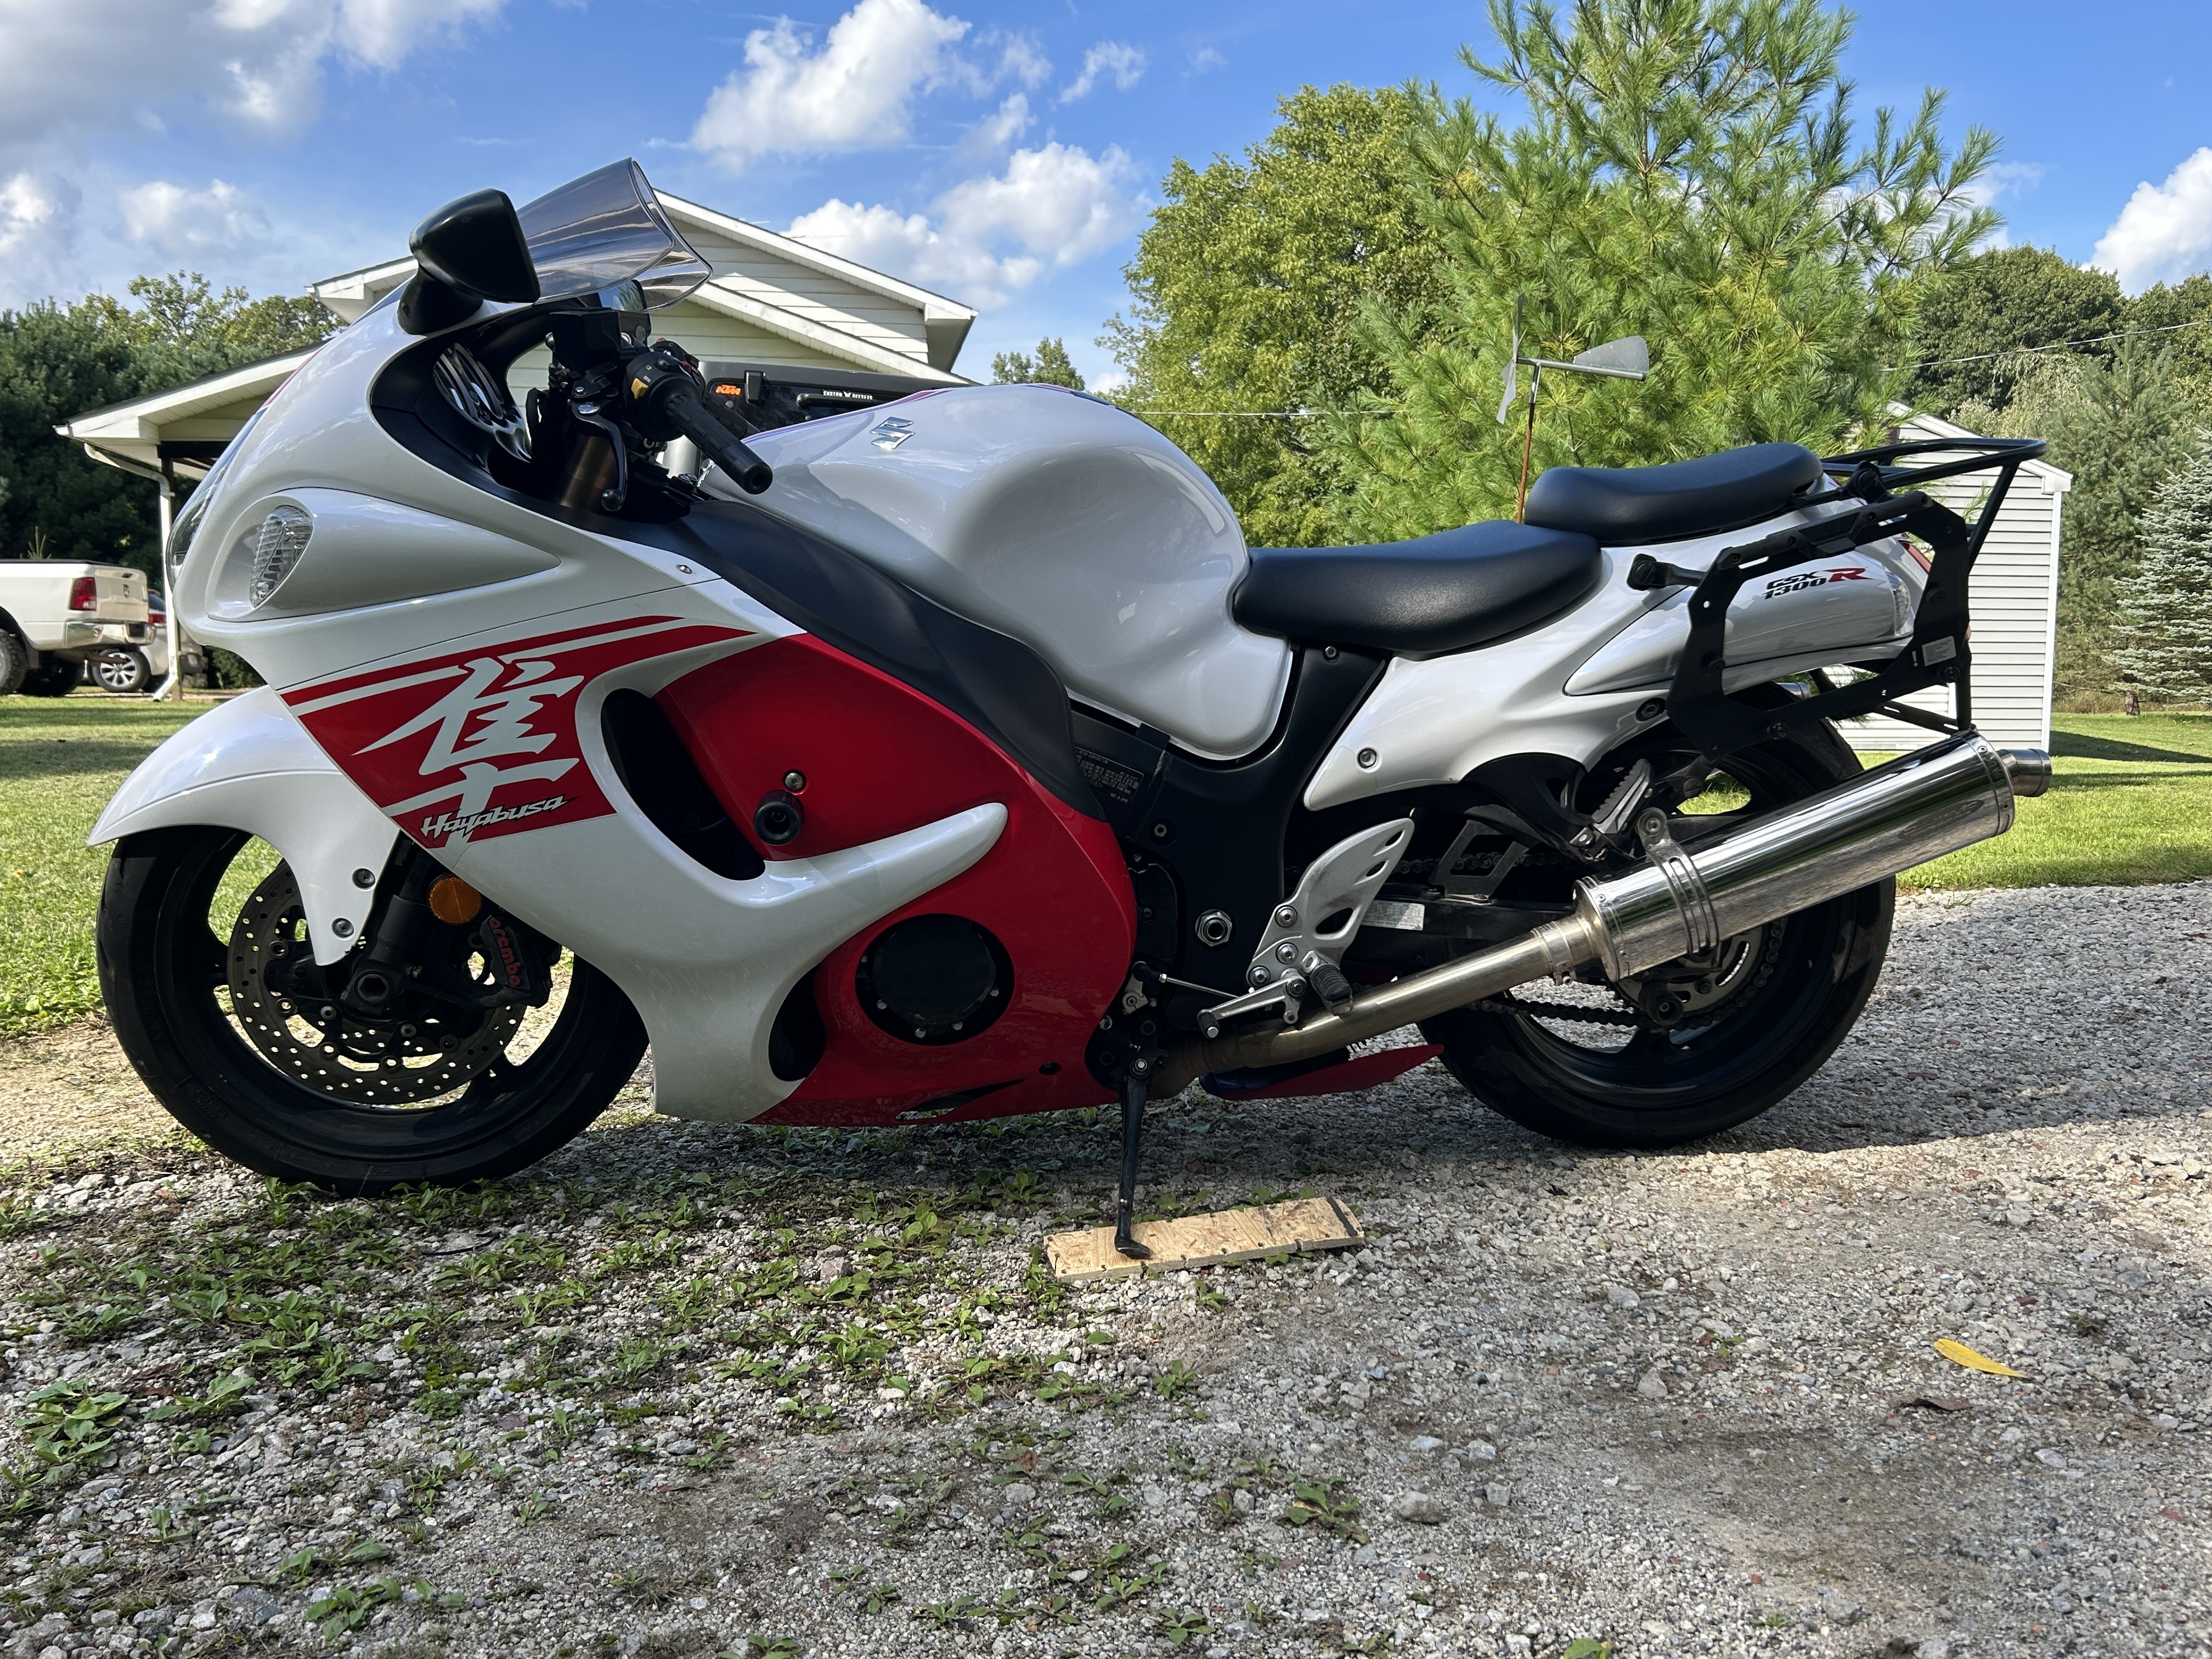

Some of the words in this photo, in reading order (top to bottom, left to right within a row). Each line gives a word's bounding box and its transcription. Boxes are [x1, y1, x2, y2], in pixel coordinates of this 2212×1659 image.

[715, 385, 741, 395] KTM
[1762, 578, 1827, 600] 1300
[1766, 570, 1822, 590] GSX
[351, 657, 585, 848] 隼
[420, 795, 574, 838] Hayabusa
